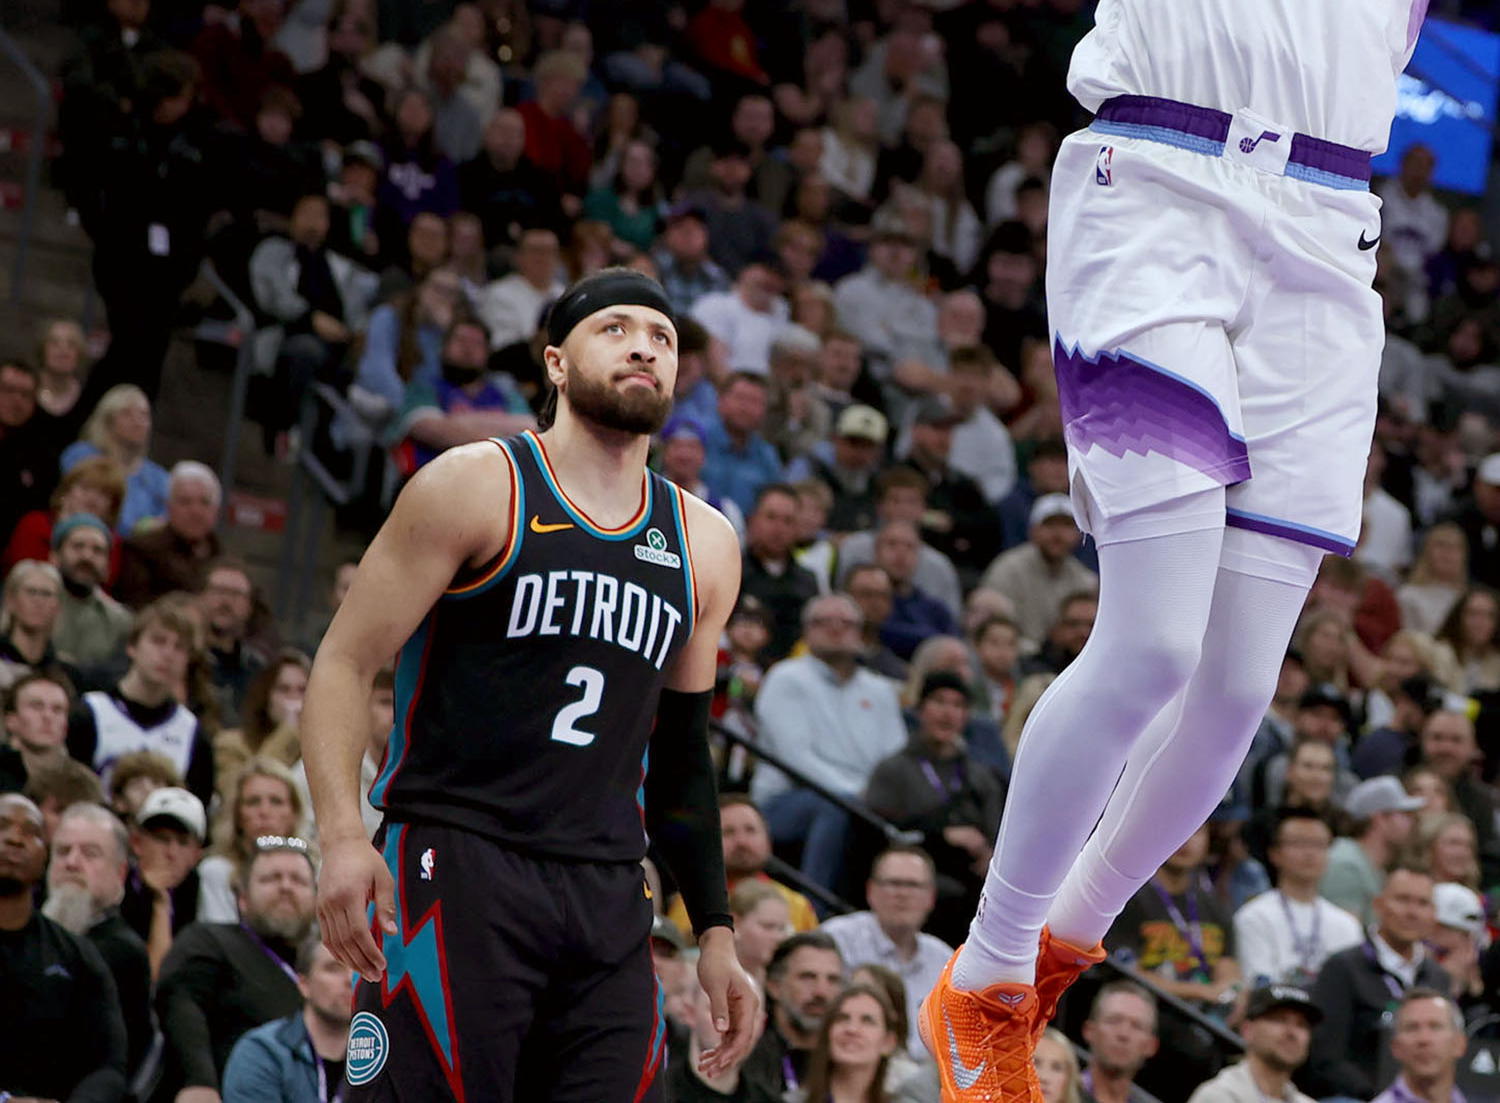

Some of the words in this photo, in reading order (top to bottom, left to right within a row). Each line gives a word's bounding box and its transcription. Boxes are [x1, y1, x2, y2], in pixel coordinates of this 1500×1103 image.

[635, 546, 680, 567] StockX
[506, 570, 682, 672] DETROIT
[550, 666, 605, 747] 2
